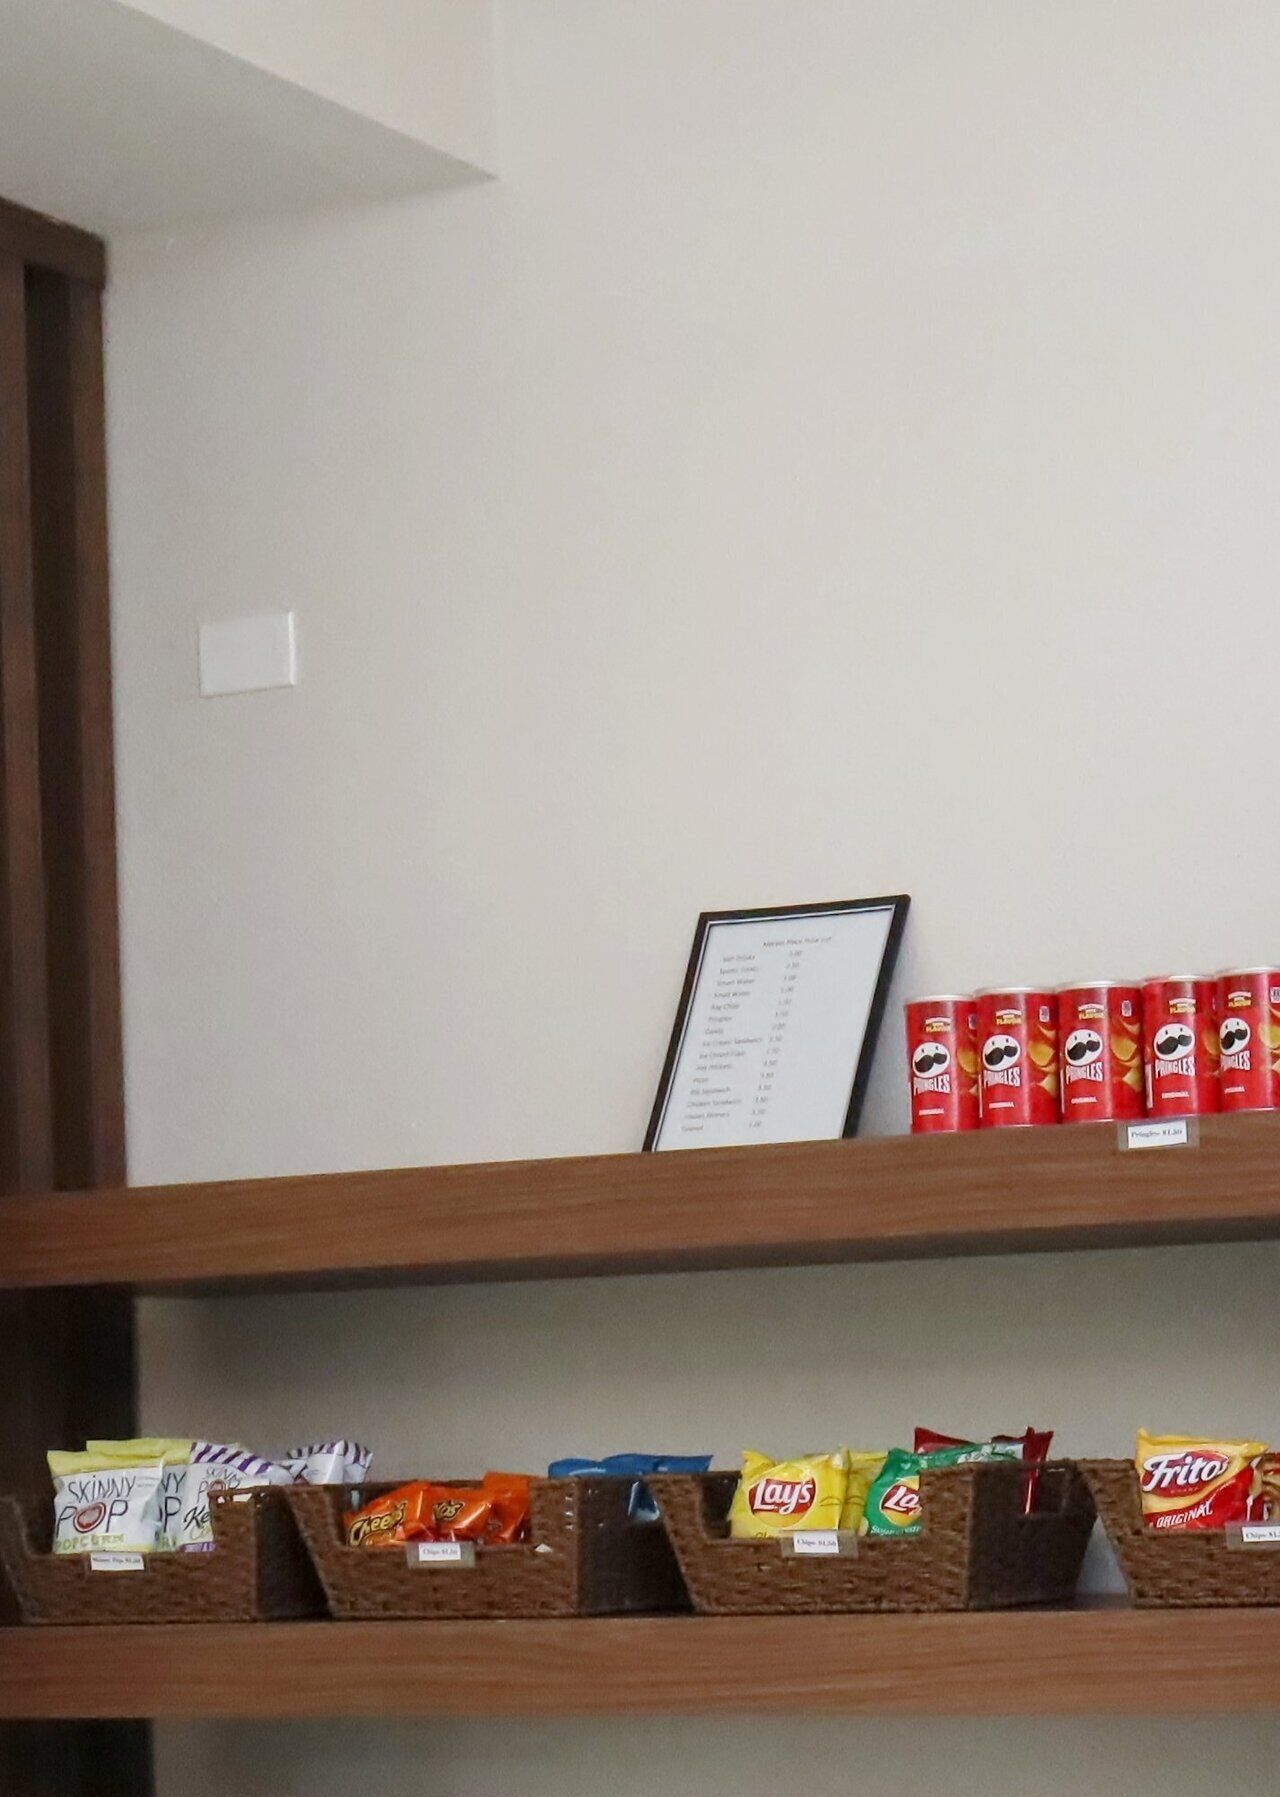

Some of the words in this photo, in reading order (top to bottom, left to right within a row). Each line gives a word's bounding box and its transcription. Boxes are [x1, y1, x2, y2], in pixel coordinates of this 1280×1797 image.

[753, 1478, 814, 1515] Lay's
[1156, 1501, 1215, 1529] ORIGINAL
[56, 1499, 129, 1539] POP
